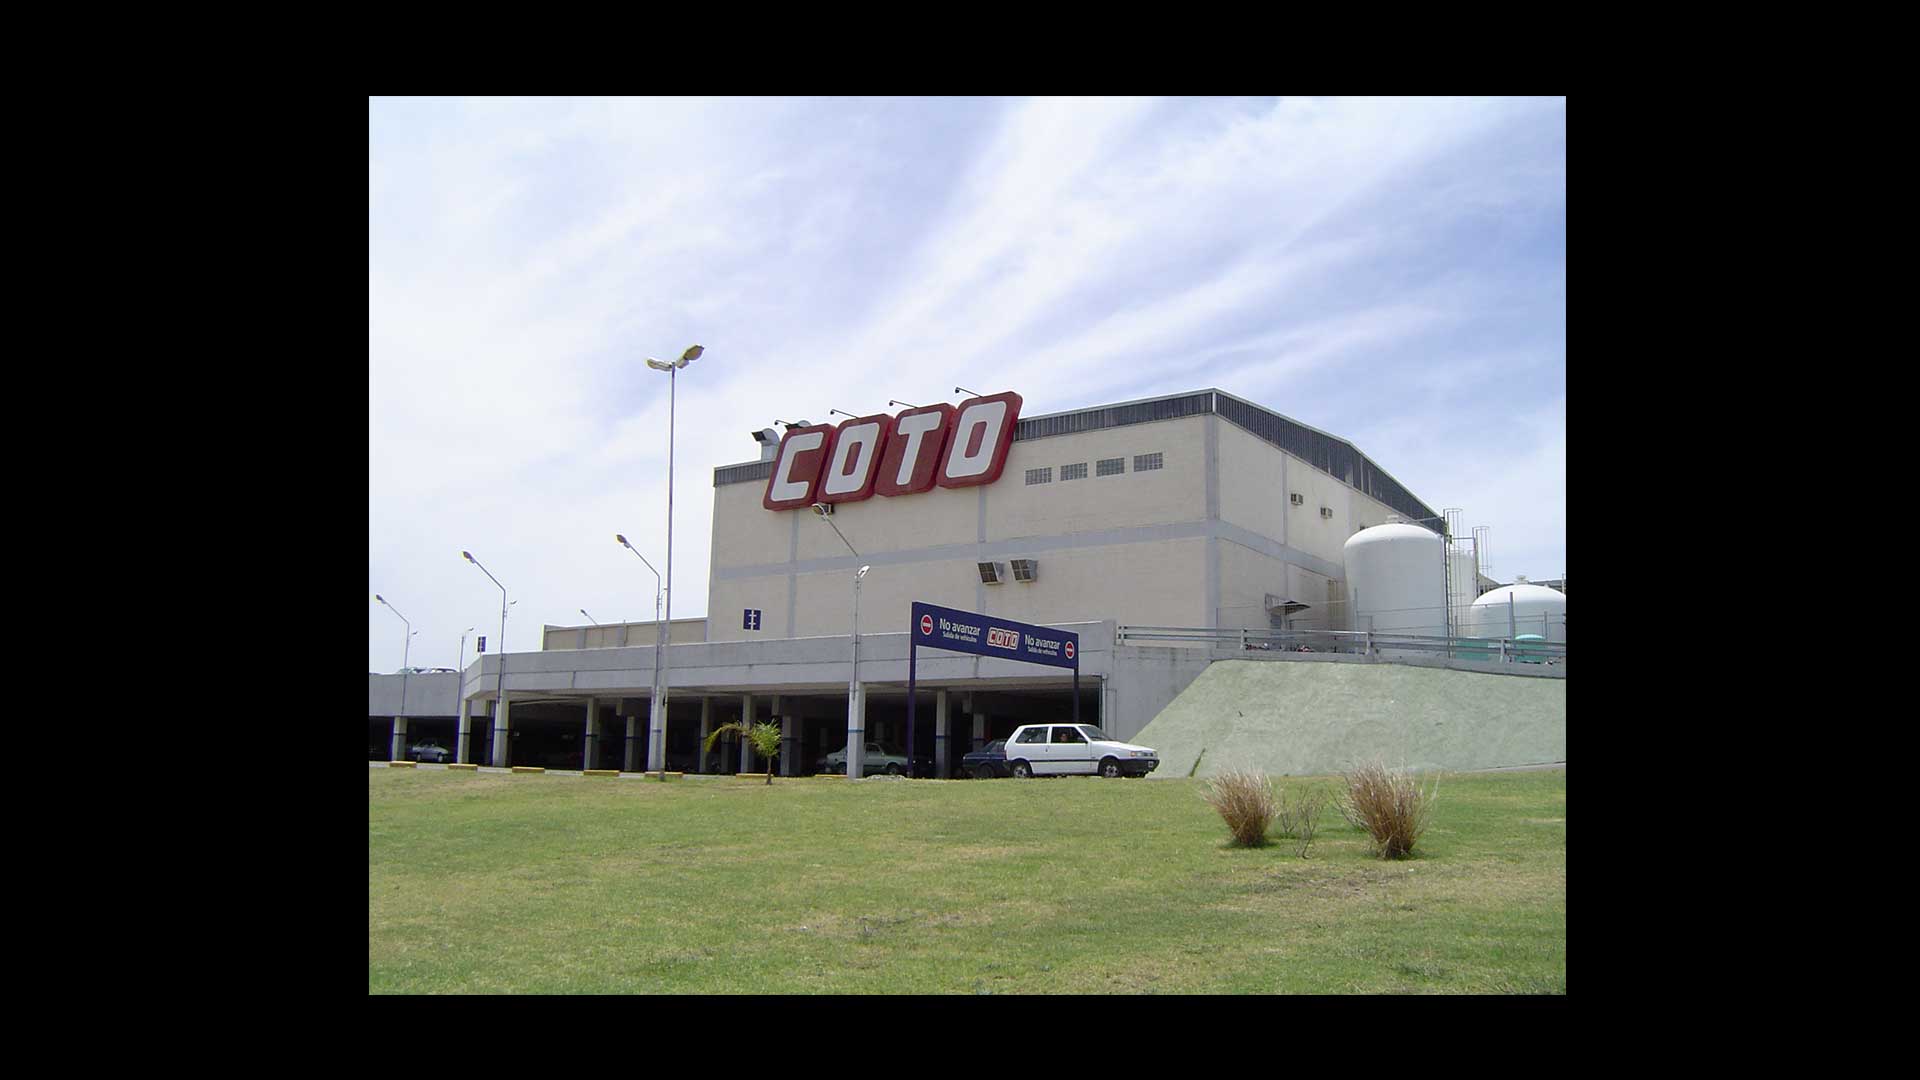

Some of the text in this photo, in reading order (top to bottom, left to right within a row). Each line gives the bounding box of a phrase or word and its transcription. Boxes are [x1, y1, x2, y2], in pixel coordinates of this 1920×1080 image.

[770, 400, 1006, 502] COTO
[939, 618, 981, 636] No avanzar
[988, 629, 1018, 649] COTO
[1024, 634, 1060, 650] No avanzar
